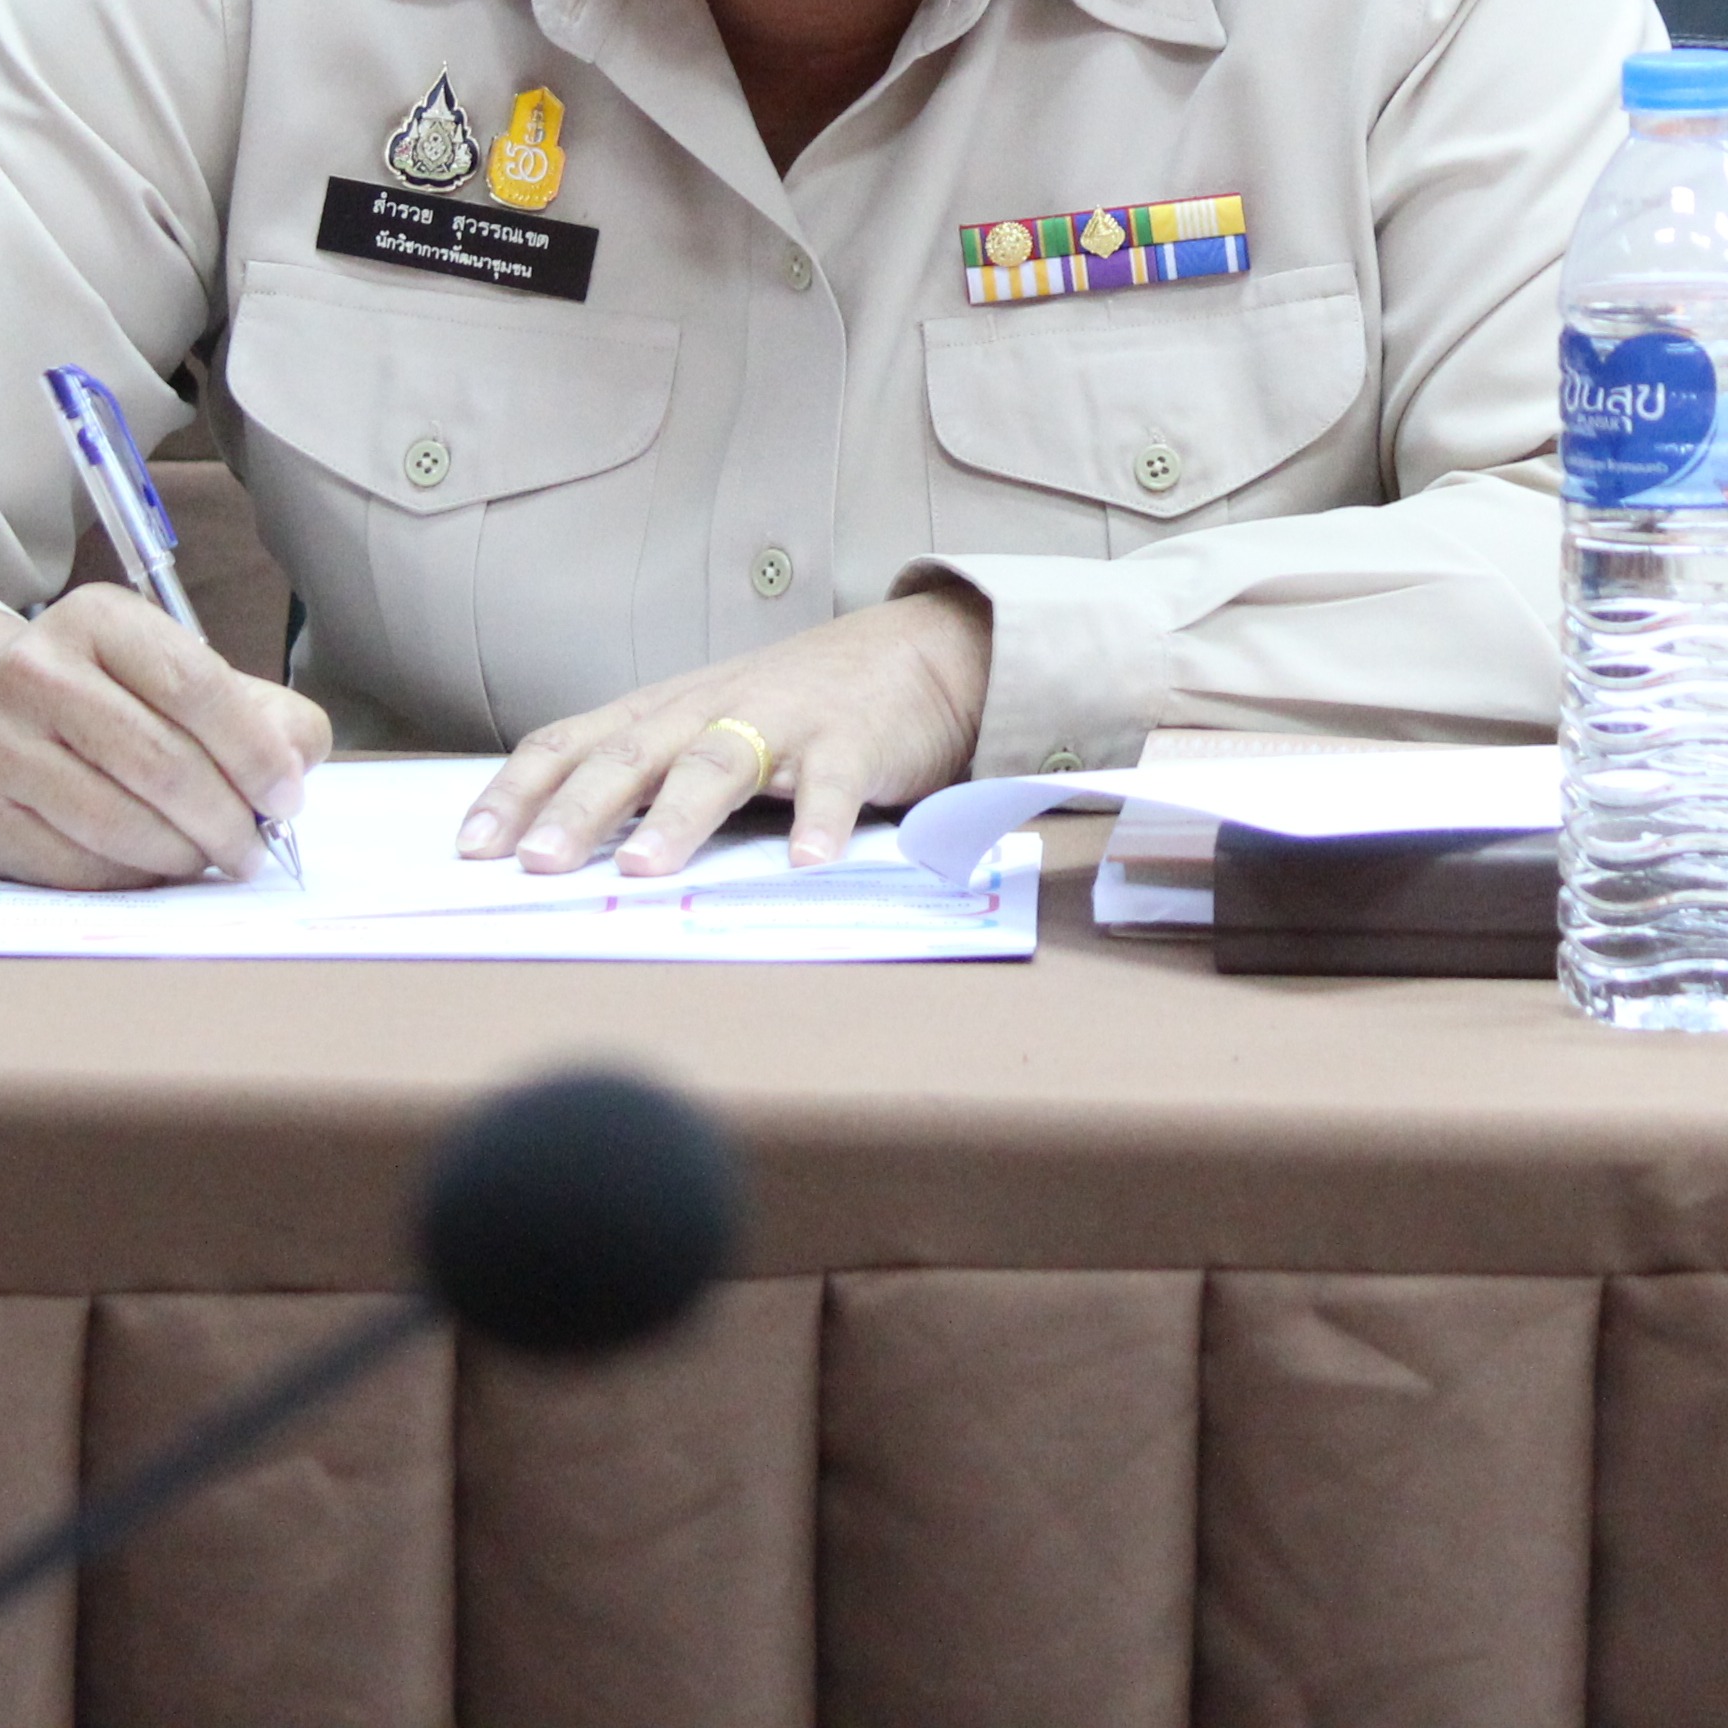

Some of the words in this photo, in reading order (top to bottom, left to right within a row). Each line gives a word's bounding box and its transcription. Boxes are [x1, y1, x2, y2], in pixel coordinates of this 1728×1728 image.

[375, 229, 533, 280] นักวิชาการพัฒนาชุมชน
